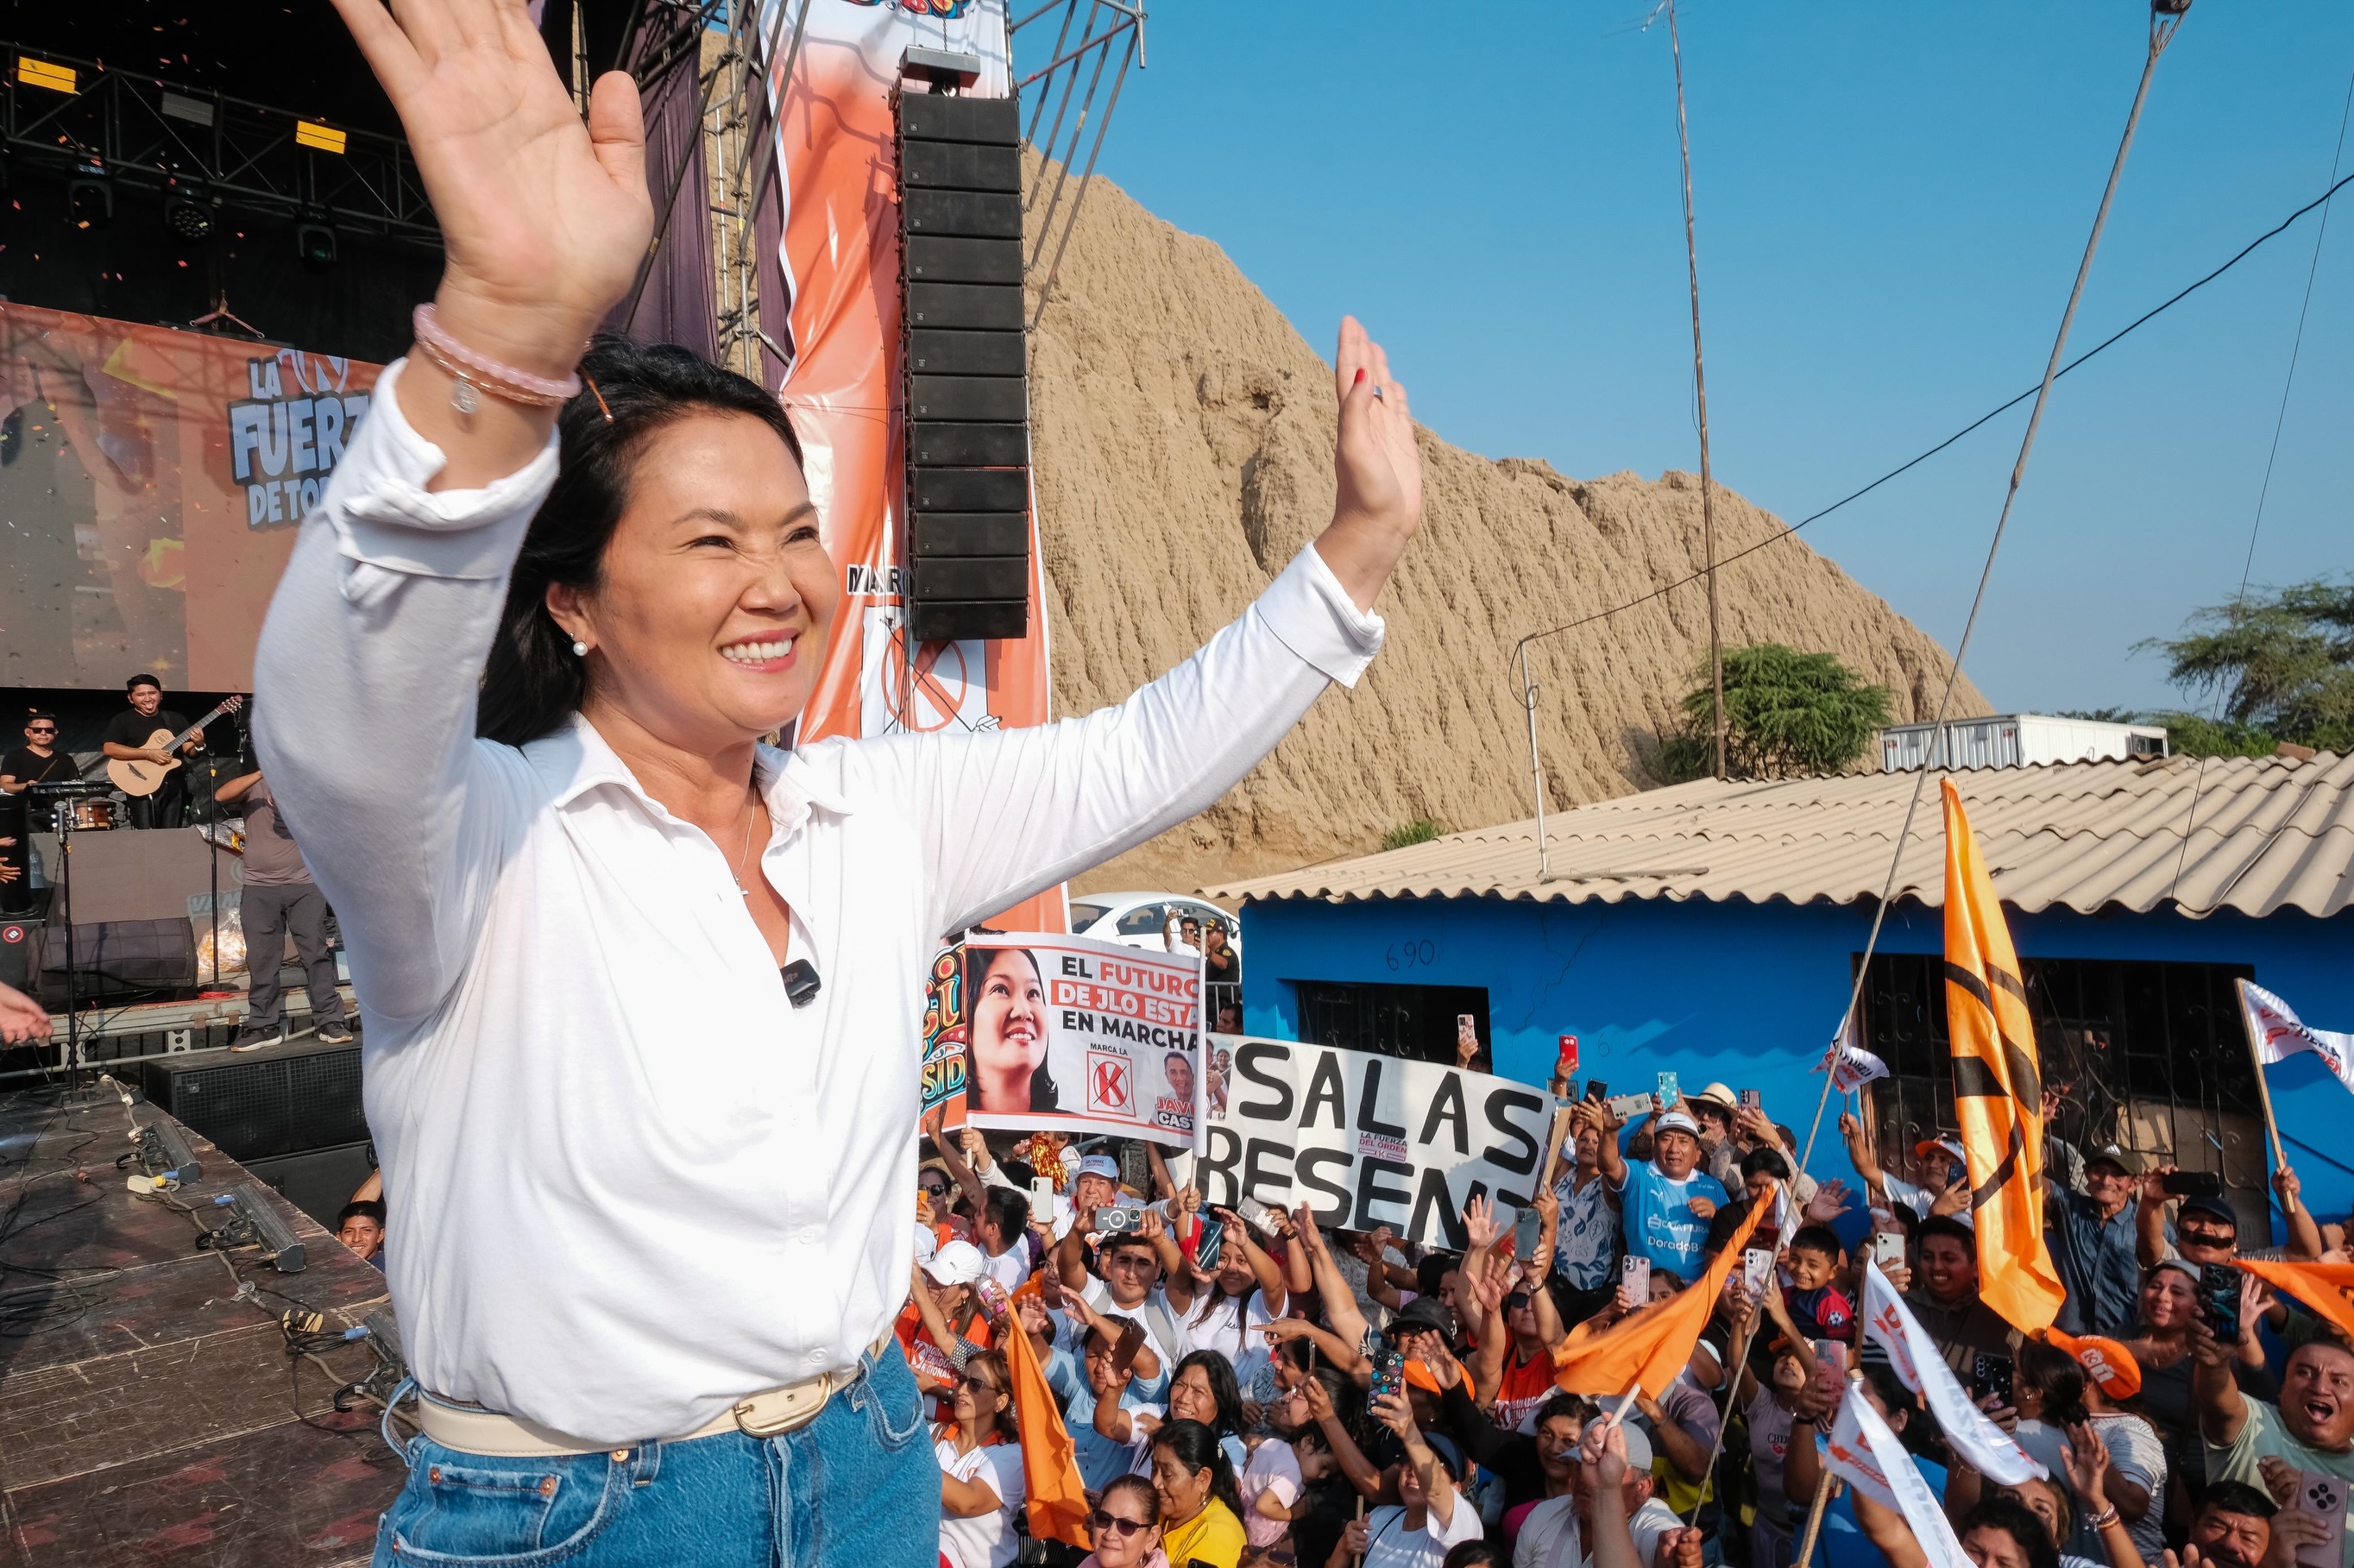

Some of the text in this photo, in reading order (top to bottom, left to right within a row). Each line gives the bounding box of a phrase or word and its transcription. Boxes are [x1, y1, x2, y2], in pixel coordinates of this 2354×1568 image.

[249, 361, 283, 400] LA
[248, 479, 283, 526] DE
[1062, 956, 1092, 979] EL
[1058, 983, 1091, 1007] DE
[1096, 989, 1138, 1016] JLO
[1062, 1011, 1198, 1052] EN MARCHA
[1090, 1042, 1128, 1056] MARCA LA
[1234, 1042, 1544, 1176] SALAS
[1360, 1138, 1375, 1147] DEL
[1378, 1142, 1407, 1154] ORDEN
[1375, 1133, 1407, 1147] FUERZA
[1165, 1124, 1533, 1254] RESEN
